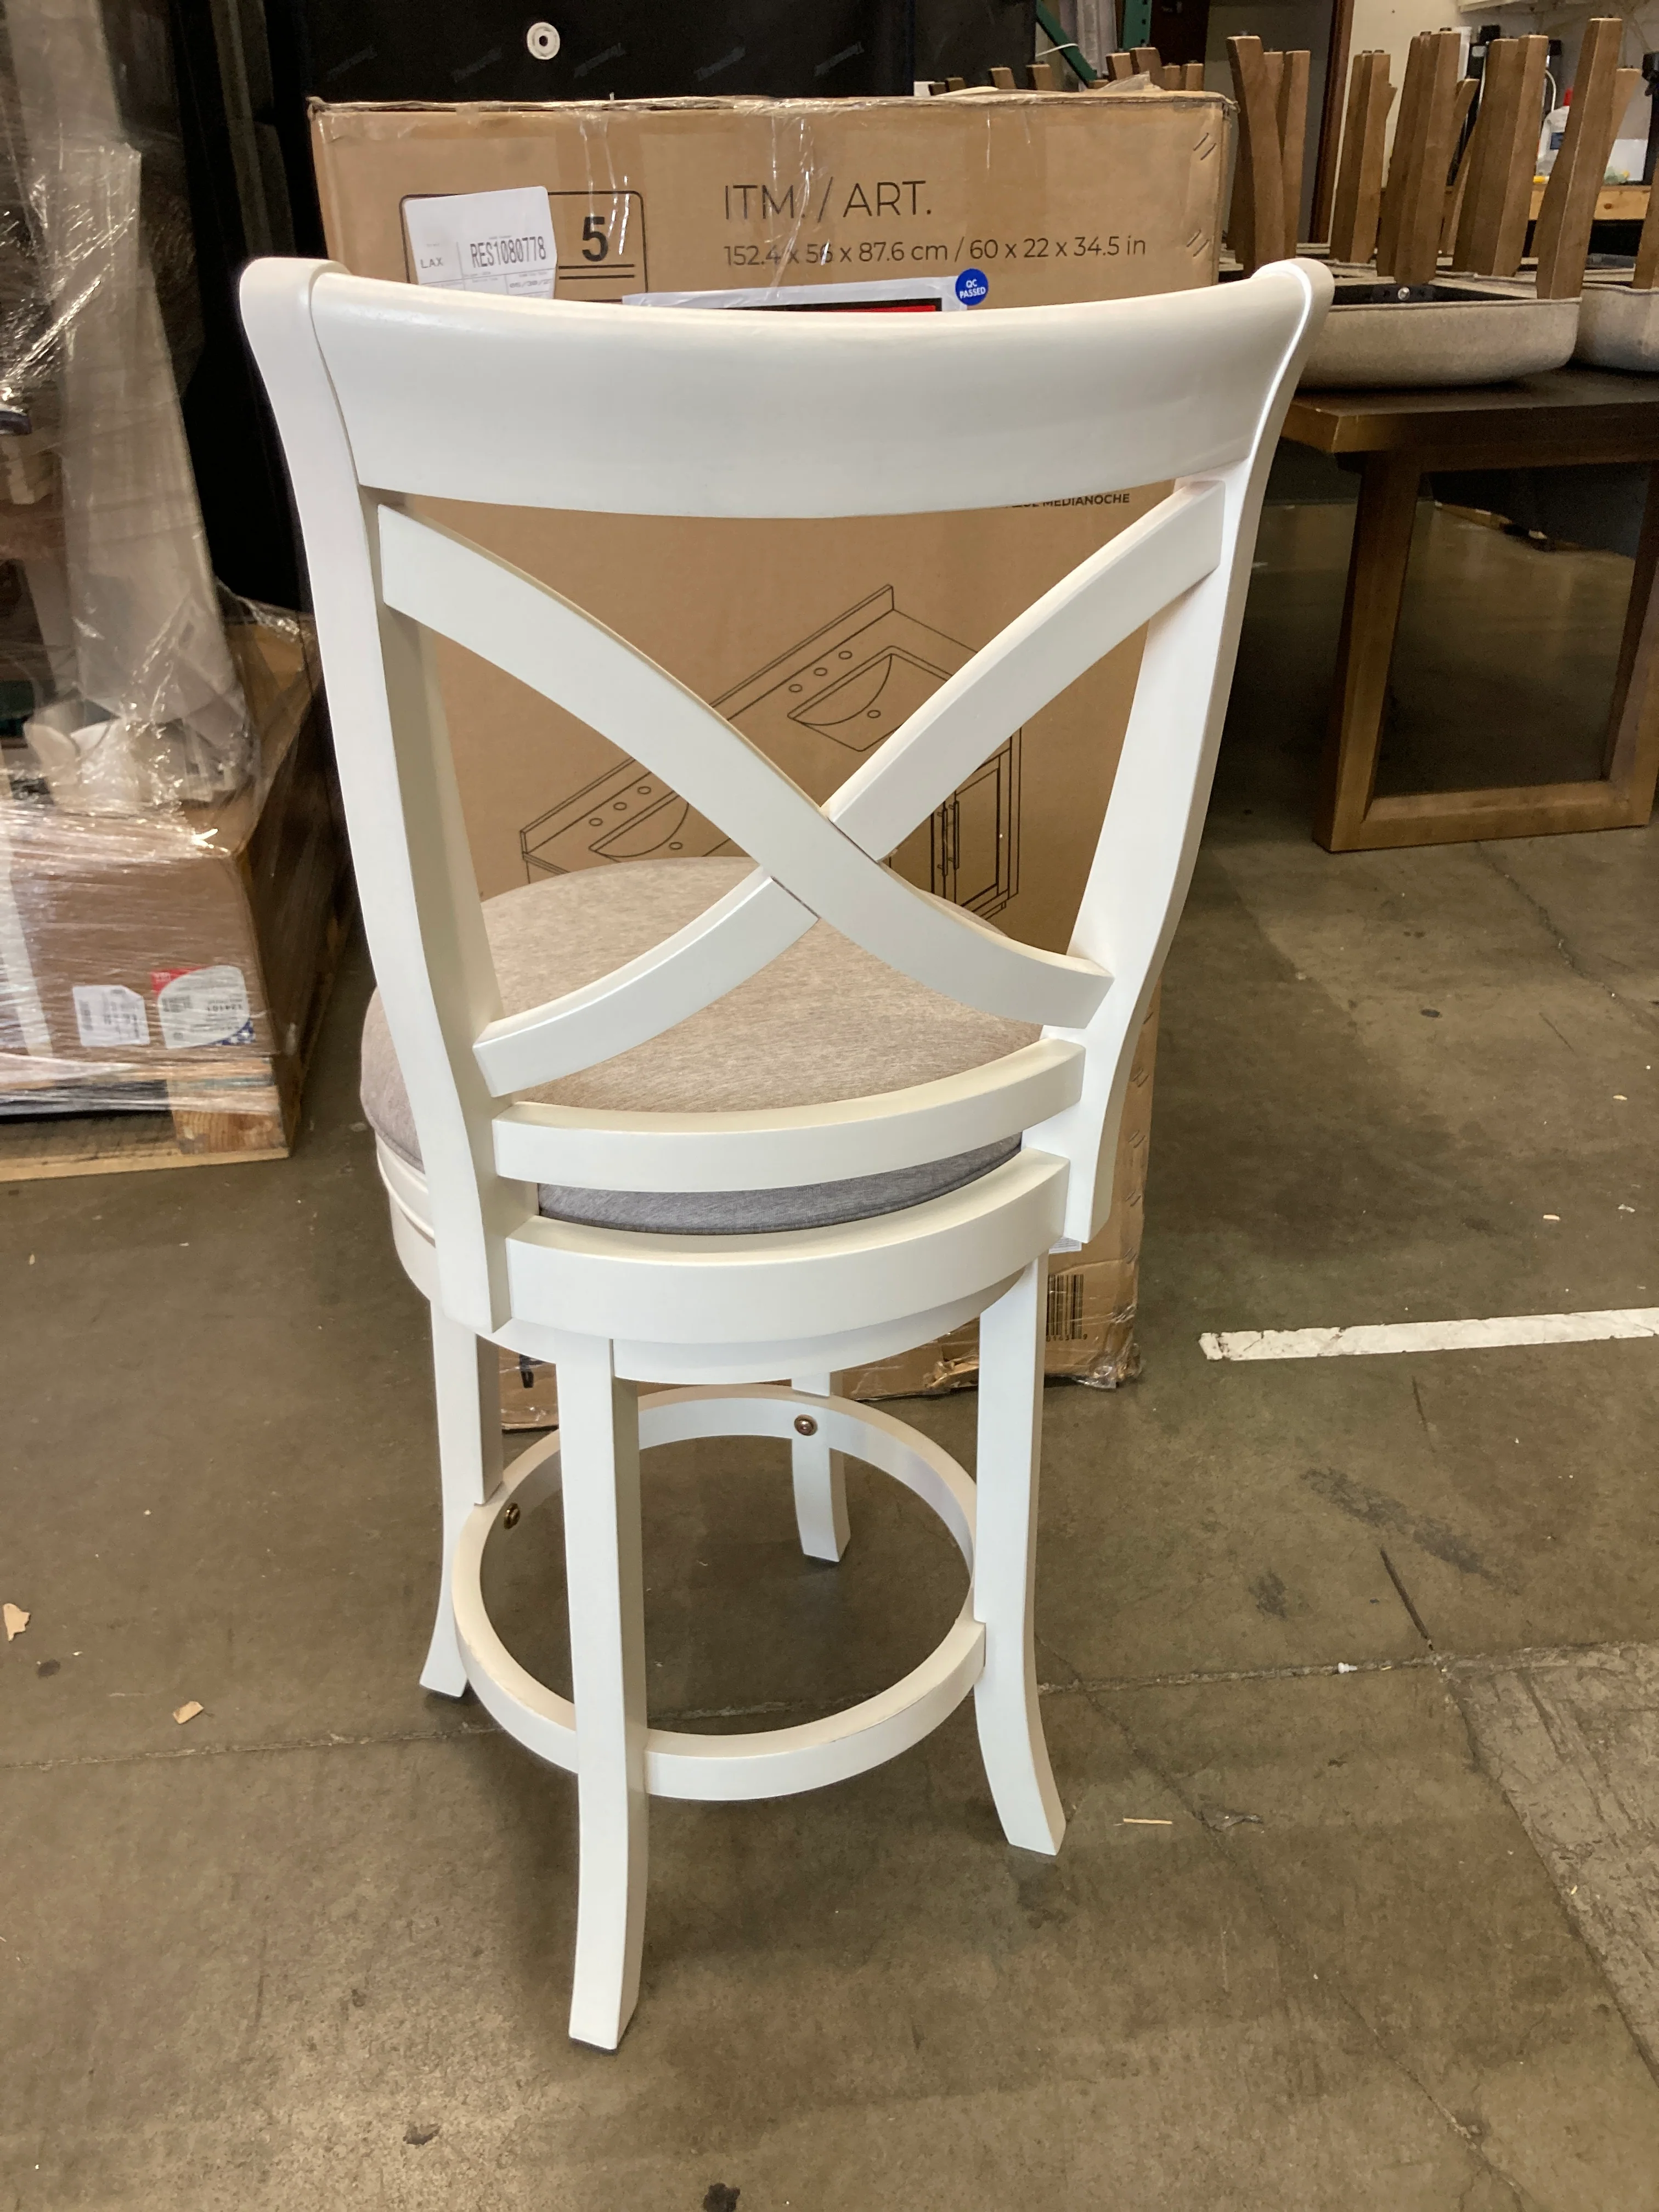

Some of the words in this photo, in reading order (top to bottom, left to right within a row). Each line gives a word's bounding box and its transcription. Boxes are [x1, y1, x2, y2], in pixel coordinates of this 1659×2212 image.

[725, 184, 805, 219] ITM.
[817, 176, 833, 223] /
[843, 180, 932, 218] ART.
[470, 235, 546, 268] RES1080778
[582, 216, 609, 262] 5
[724, 244, 781, 266] 152.4
[786, 251, 799, 264] x
[806, 243, 833, 264] 56
[839, 247, 852, 263] x
[859, 241, 905, 262] 87.6
[911, 244, 947, 261] cm
[954, 236, 964, 263] /
[969, 239, 998, 260] 60
[1005, 243, 1017, 259] x
[1023, 238, 1049, 258] 22
[1055, 241, 1068, 257] x
[1073, 236, 1120, 257] 34.5
[1127, 234, 1146, 255] in
[420, 257, 444, 269] LAX
[959, 286, 986, 299] PASSED
[966, 279, 978, 288] QC
